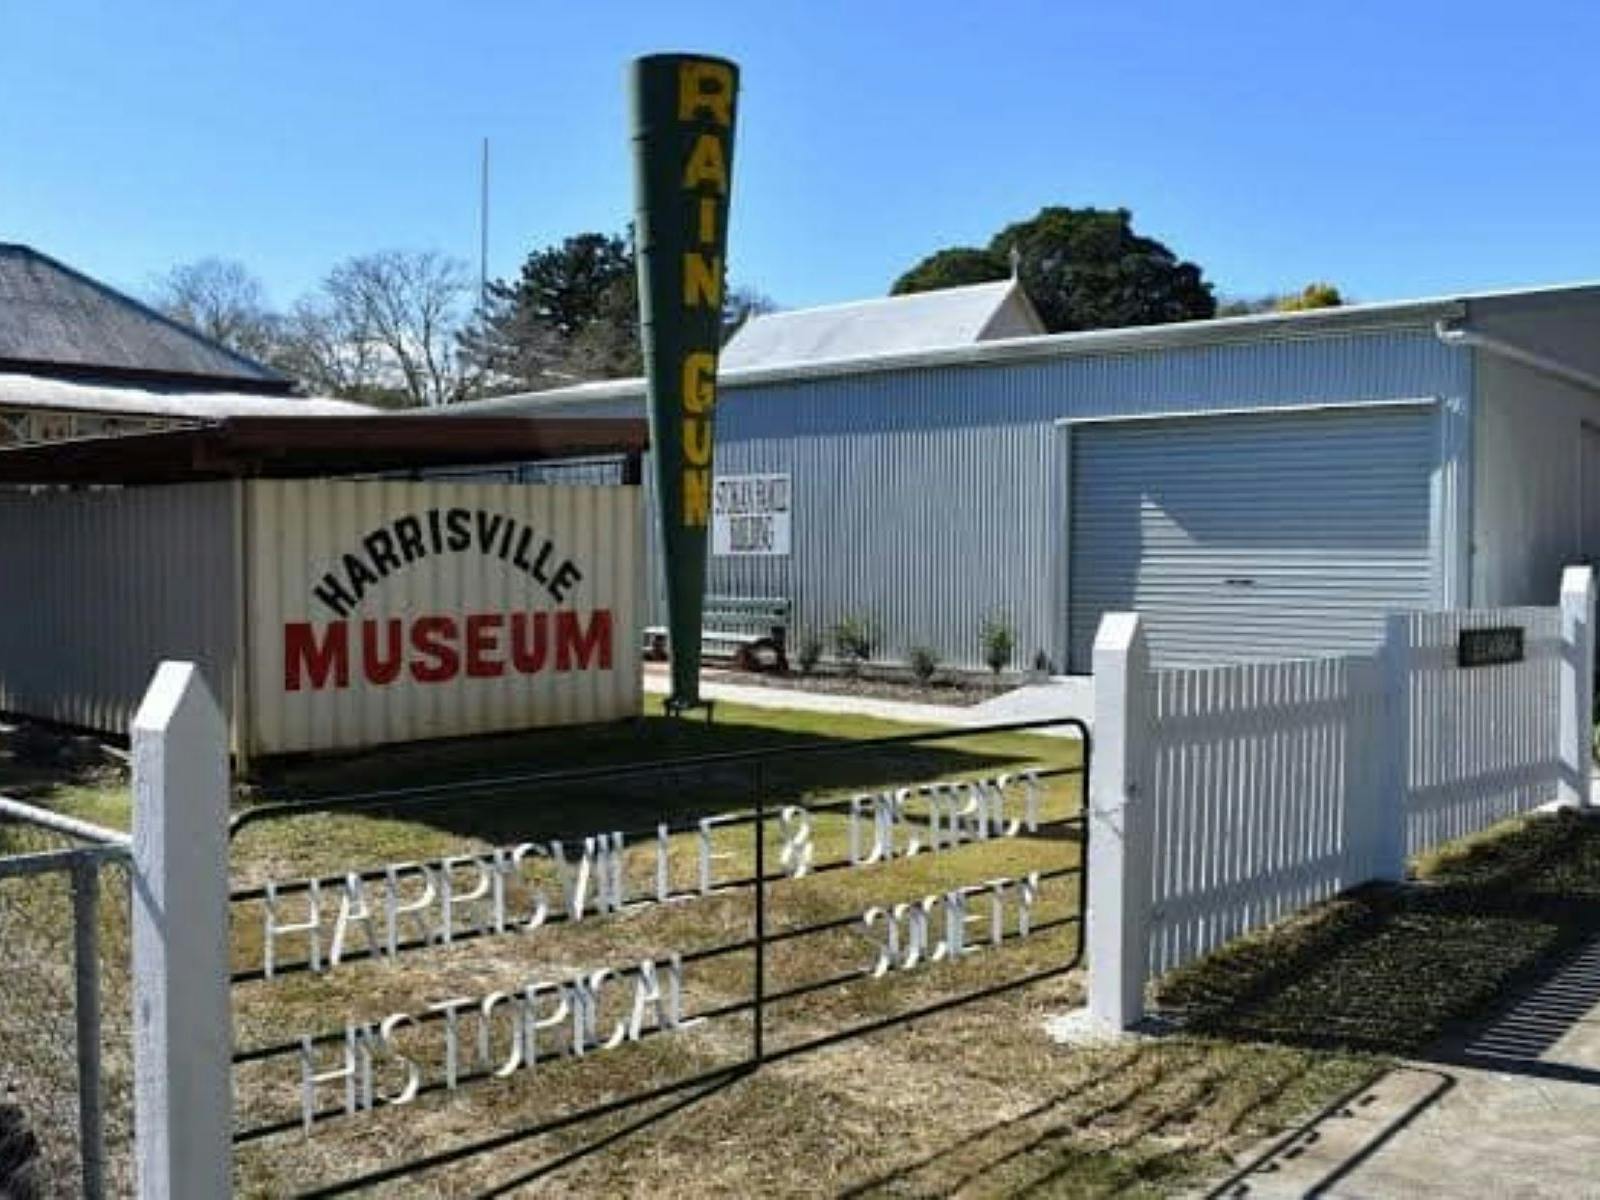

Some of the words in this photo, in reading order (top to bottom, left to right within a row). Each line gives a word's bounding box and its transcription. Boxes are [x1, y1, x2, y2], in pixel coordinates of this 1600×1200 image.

[678, 61, 733, 311] RAIN
[683, 353, 716, 527] GUN
[313, 507, 582, 617] HARRISVILLE
[284, 609, 613, 691] MUSEUM
[780, 805, 814, 879] &
